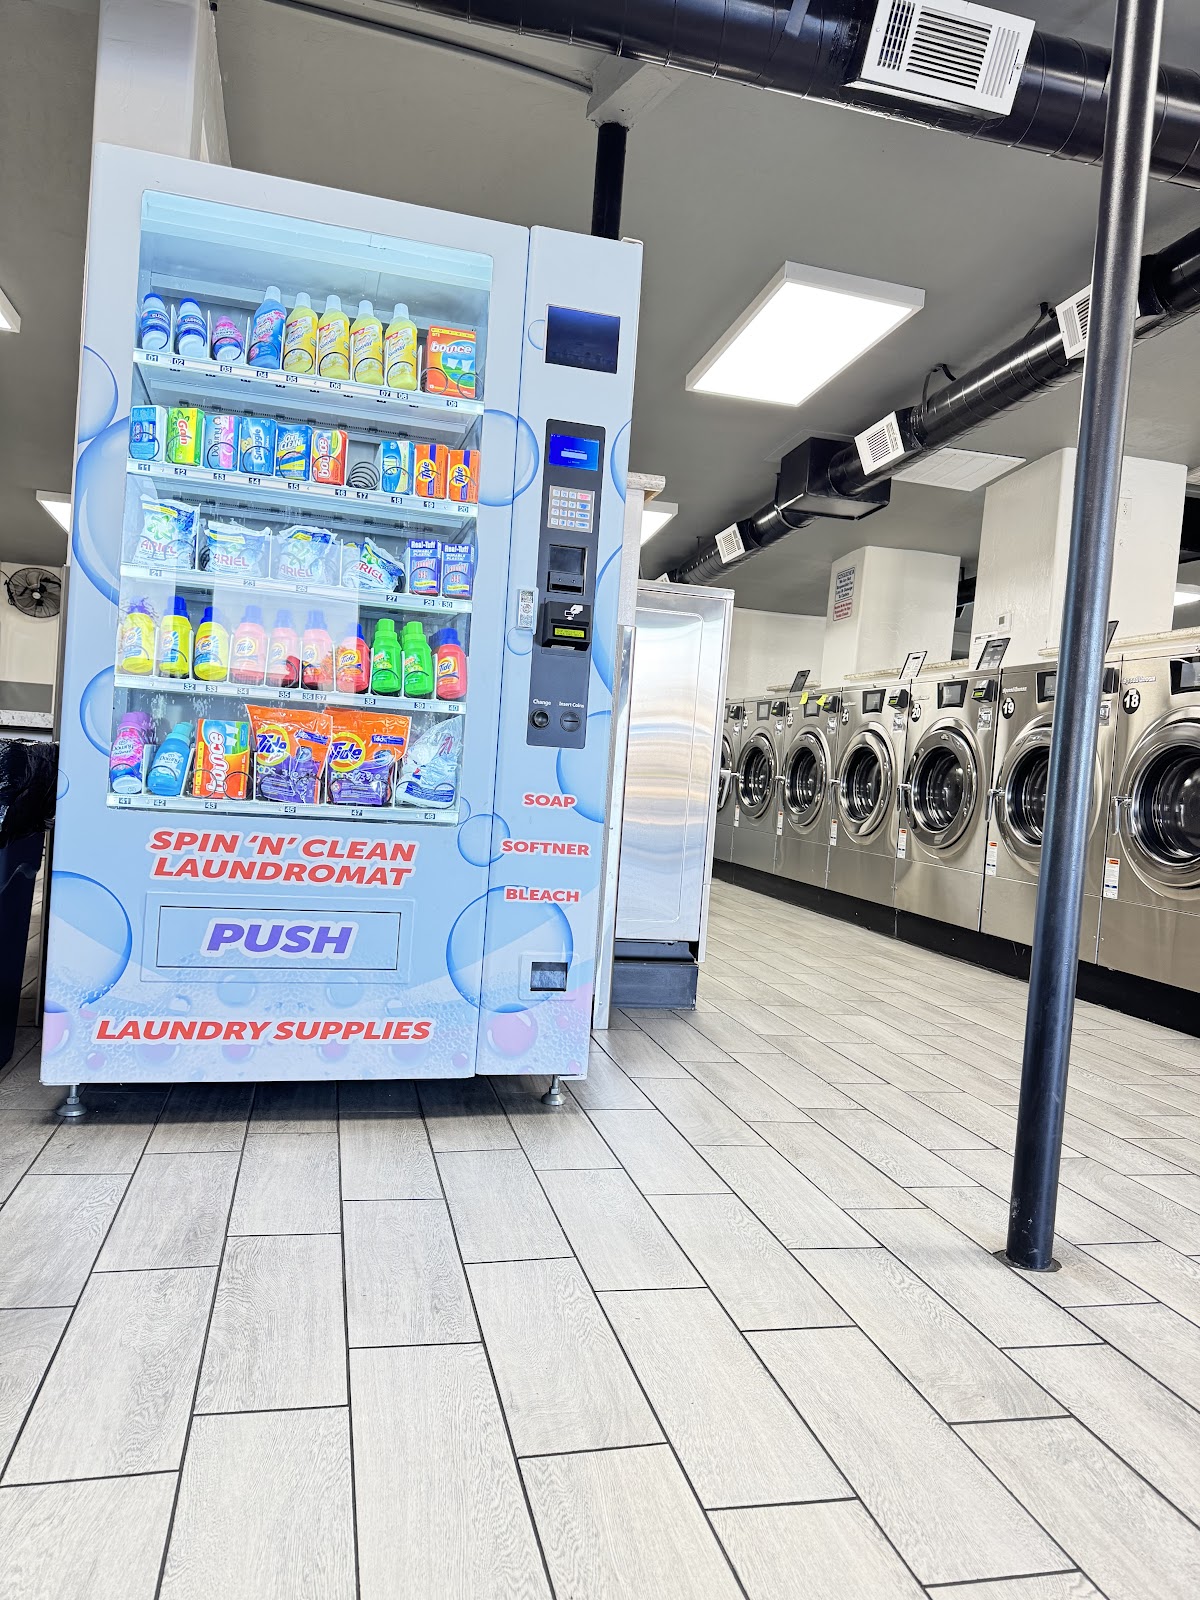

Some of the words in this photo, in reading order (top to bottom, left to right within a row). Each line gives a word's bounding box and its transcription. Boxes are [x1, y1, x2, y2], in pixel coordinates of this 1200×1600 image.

[430, 341, 473, 354] bounce
[147, 354, 158, 363] 01
[173, 358, 184, 367] 02
[221, 365, 232, 374] 03
[257, 371, 268, 380] 04
[380, 390, 390, 398] 07
[177, 419, 188, 445] Gain
[211, 427, 222, 457] Downy
[252, 428, 263, 461] Snuggle
[279, 438, 304, 451] CLEAN
[317, 437, 330, 478] bounce
[139, 464, 150, 472] 11
[175, 468, 186, 476] 12
[421, 461, 432, 480] Tide
[455, 466, 465, 485] Tide
[250, 478, 260, 486] 14
[289, 483, 299, 491] 15
[425, 501, 434, 509] 19
[458, 505, 468, 513] 20
[140, 539, 177, 555] ARIEL
[150, 569, 161, 577] 21
[279, 562, 315, 578] ARIEL
[236, 641, 253, 653] Tide
[340, 654, 356, 665] Tide
[438, 662, 453, 674] Tide
[185, 683, 195, 691] 32
[280, 691, 290, 699] 35
[303, 692, 313, 700] 36
[416, 701, 425, 709] 39
[532, 698, 551, 706] Change
[1124, 694, 1139, 709] 18
[911, 707, 921, 718] 20
[1002, 702, 1015, 714] 19
[256, 733, 288, 754] Tide
[329, 741, 363, 761] Tide
[160, 755, 181, 764] Downy
[205, 731, 230, 794] bounce
[330, 772, 355, 781] PODS
[120, 797, 130, 805] 41
[206, 802, 216, 810] 43
[523, 793, 576, 808] SOAP
[352, 809, 362, 817] 47
[149, 830, 241, 853] SPIN
[302, 838, 416, 862] CLEAN
[501, 840, 590, 856] SOFTNER
[153, 857, 412, 886] LAUNDROMAT
[505, 888, 580, 902] BLEACH
[206, 923, 353, 954] PUSH
[95, 1020, 272, 1040] LAUNDRY
[272, 1021, 433, 1040] SUPPLIES
